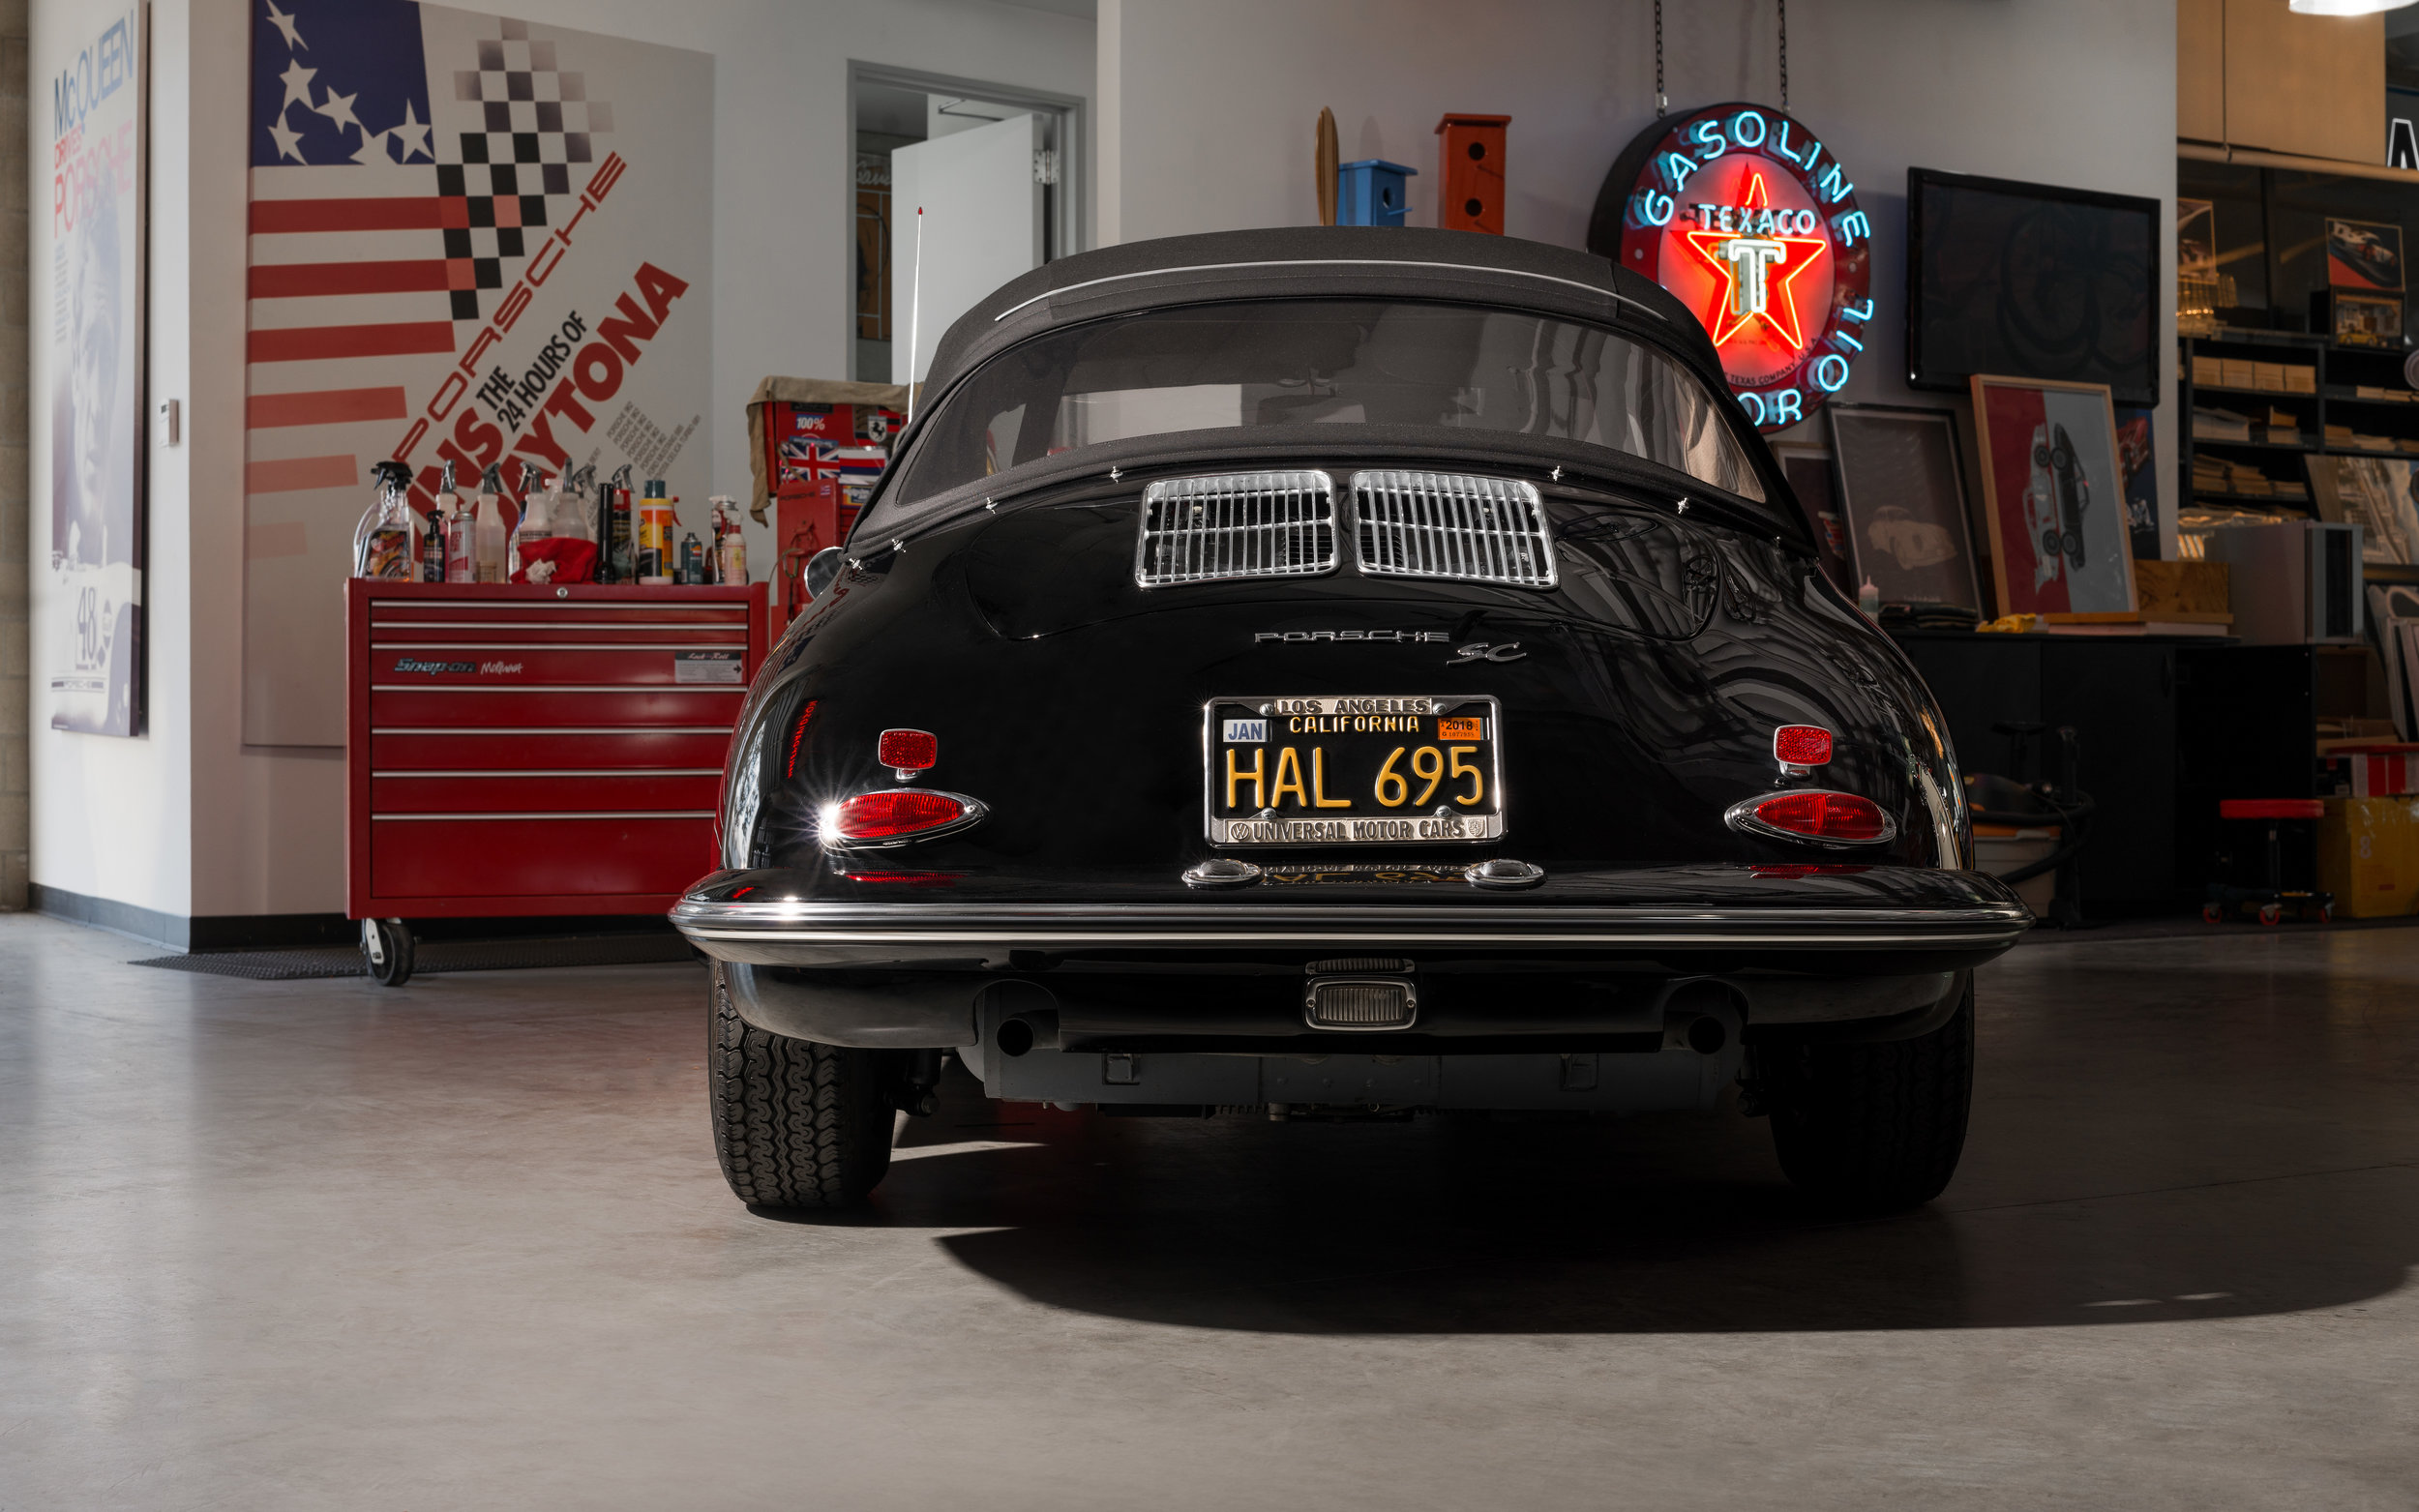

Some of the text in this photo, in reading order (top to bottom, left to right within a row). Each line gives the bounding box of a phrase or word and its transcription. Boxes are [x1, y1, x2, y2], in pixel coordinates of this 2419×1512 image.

[54, 9, 134, 141] McQUEEN
[54, 123, 83, 170] DRIVES
[54, 118, 133, 240] PORSCHE
[1643, 110, 1871, 248] GASOLINE
[1698, 203, 1816, 234] TEXACO
[391, 151, 627, 463] PORSCHE
[1817, 298, 1874, 392] OIL
[496, 310, 587, 433] 24 HOURS OF
[1730, 373, 1757, 386] TEXAS
[475, 365, 516, 411] THE
[796, 416, 825, 431] 100%
[77, 586, 97, 662] 48
[1254, 630, 1449, 643] PORSCHE
[394, 658, 477, 675] Snap-on
[1447, 641, 1527, 665] SC
[1280, 699, 1428, 714] LOS ANGELES
[1228, 723, 1263, 741] JAN
[1290, 716, 1419, 733] CALIFORNIA
[1446, 720, 1473, 730] 2018
[1227, 746, 1483, 809] HAL 695
[1252, 822, 1346, 841] UNIVERSAL
[1353, 820, 1413, 840] MOTOR
[1418, 820, 1465, 838] CARS
